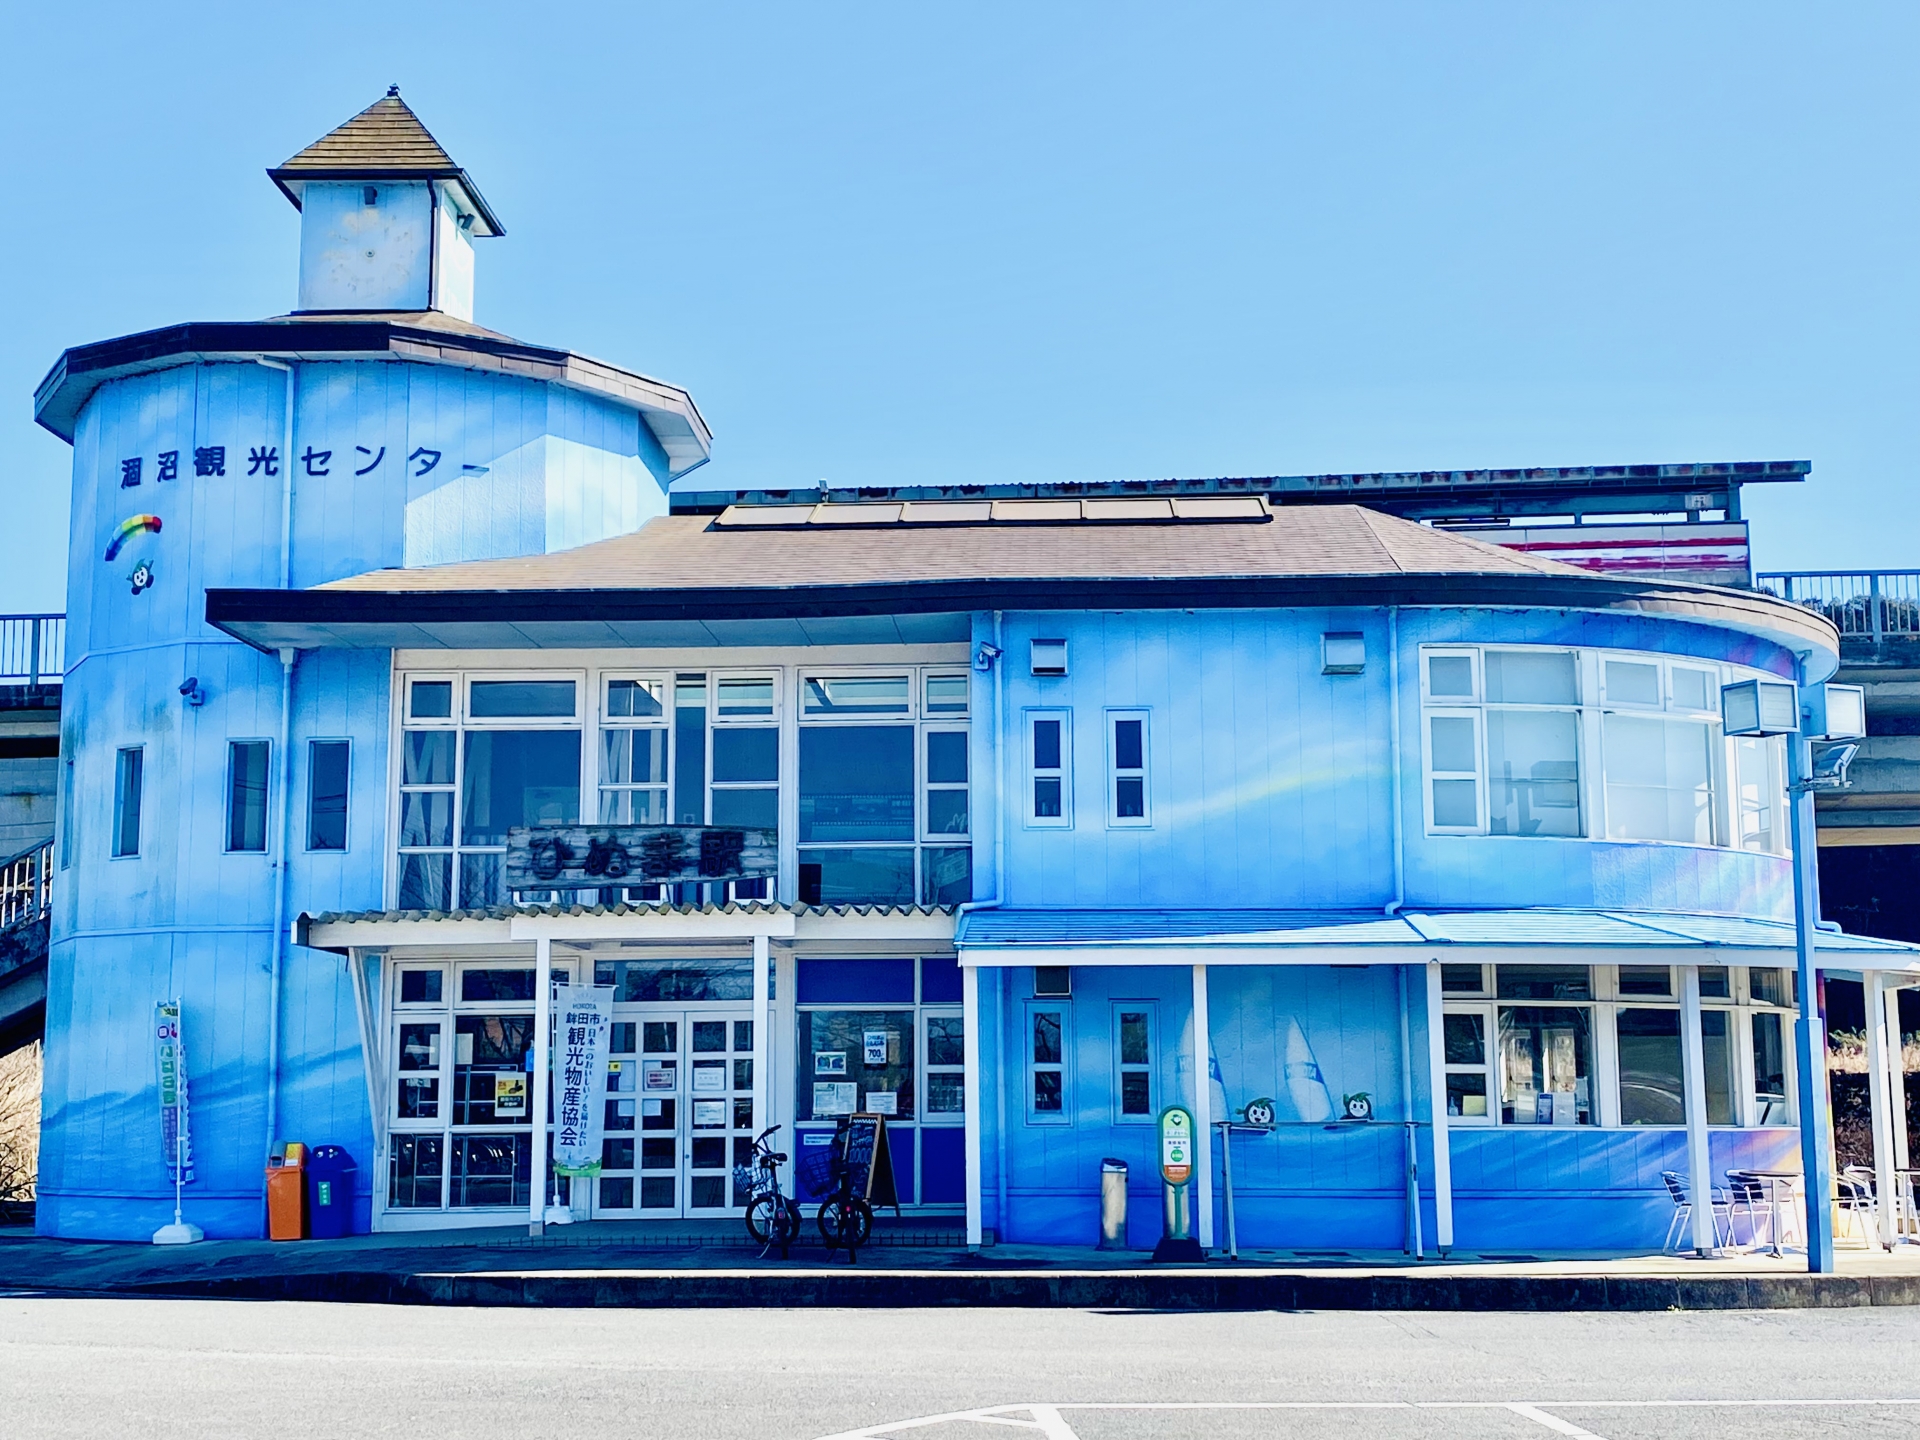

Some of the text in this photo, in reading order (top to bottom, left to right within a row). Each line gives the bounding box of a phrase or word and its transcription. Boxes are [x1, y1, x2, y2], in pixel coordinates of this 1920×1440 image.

[121, 445, 490, 490] 涸沼観光センター
[566, 1012, 601, 1025] 鉾田市
[560, 1027, 586, 1146] 観光物産協会
